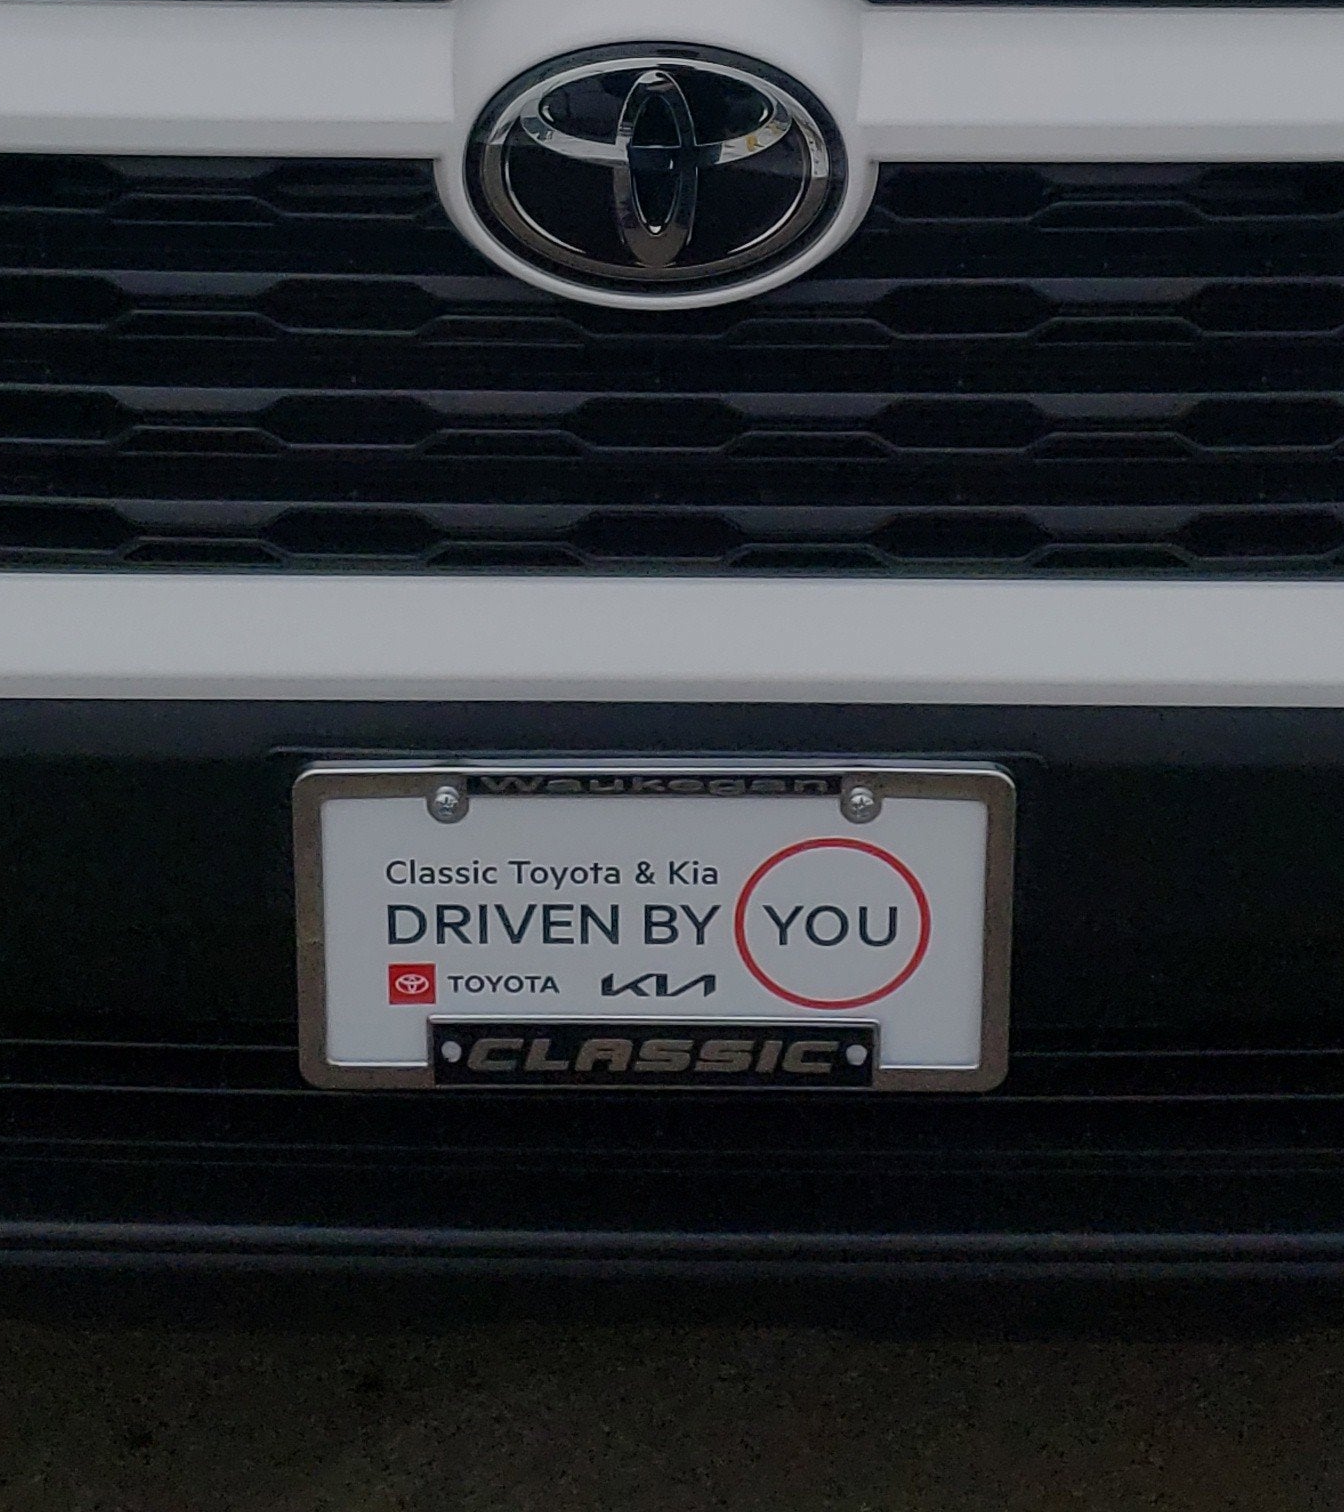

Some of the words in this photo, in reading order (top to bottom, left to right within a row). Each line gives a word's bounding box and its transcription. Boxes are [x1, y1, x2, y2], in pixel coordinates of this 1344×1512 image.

[386, 859, 498, 885] Classic
[508, 860, 621, 890] Toyota
[635, 861, 656, 885] &
[669, 860, 719, 885] Kia
[387, 904, 620, 945] DRIVEN
[644, 904, 721, 945] BY
[763, 905, 898, 947] YOU
[447, 975, 560, 994] TOYOTA
[466, 1038, 839, 1073] CLASSIC
